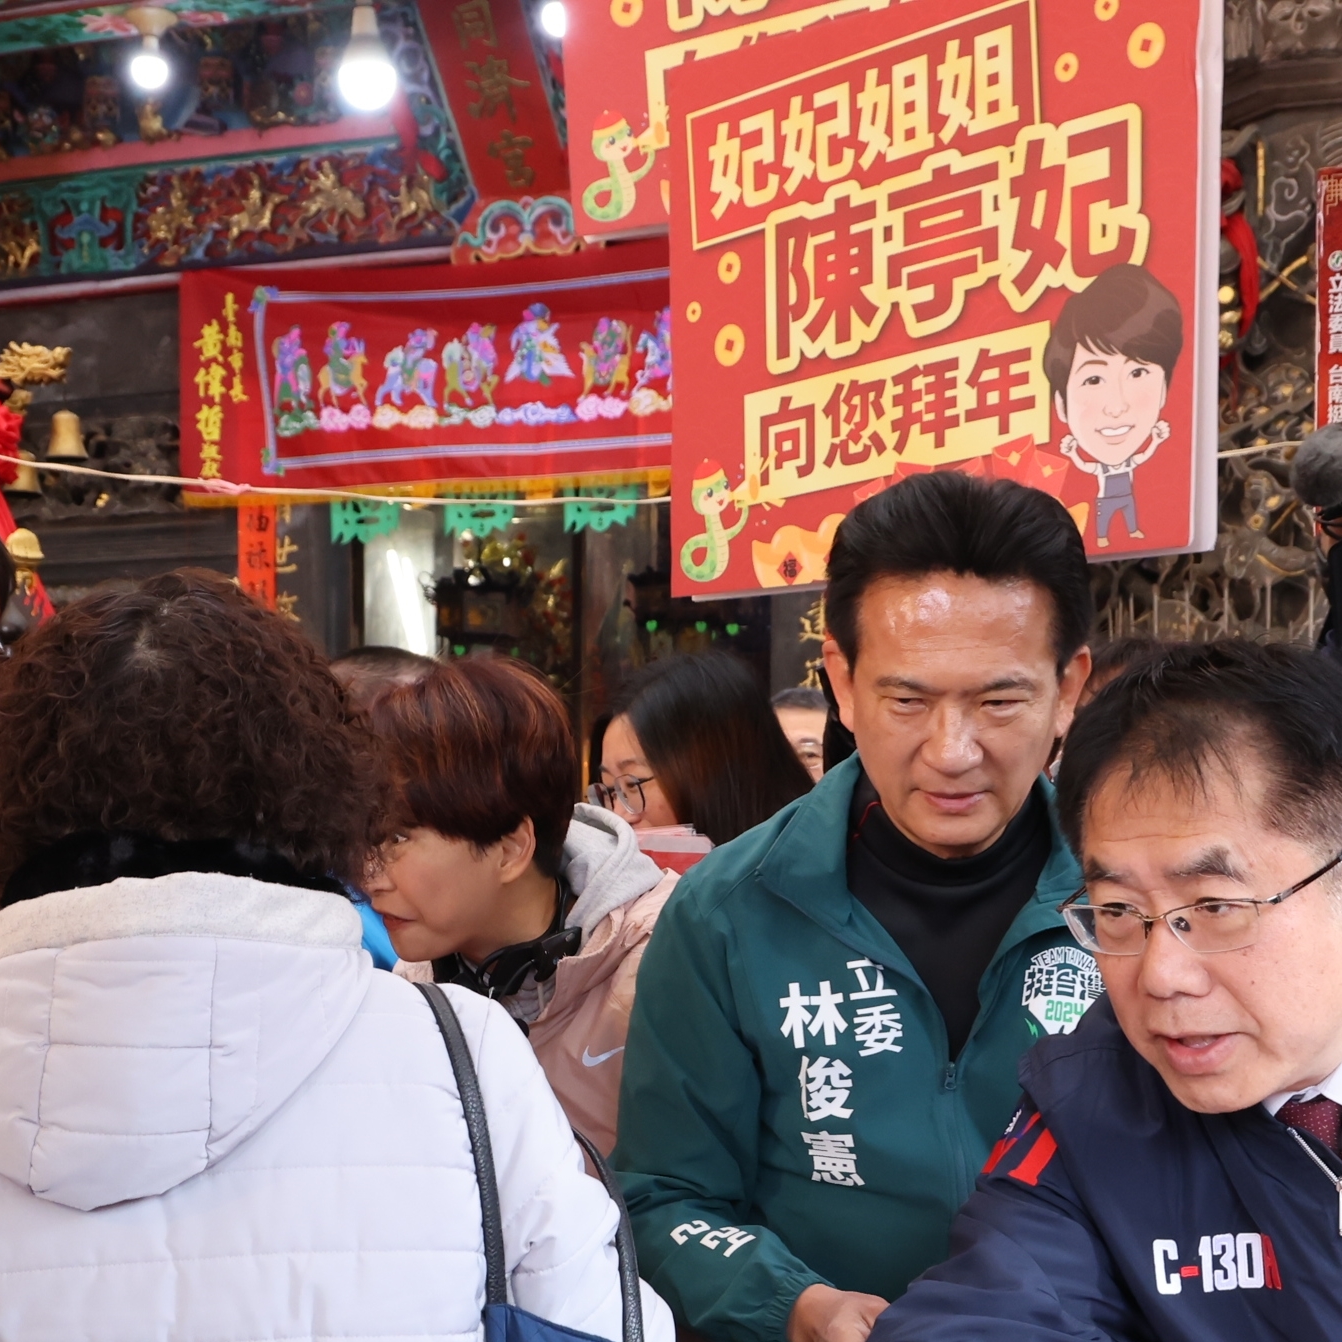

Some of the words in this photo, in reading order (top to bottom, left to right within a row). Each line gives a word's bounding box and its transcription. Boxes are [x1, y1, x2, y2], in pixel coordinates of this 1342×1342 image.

[708, 25, 1020, 220] 妃妃姐姐
[766, 105, 1150, 373] 陳亭妃
[758, 346, 1036, 485] 向您拜年
[846, 957, 904, 1057] 立委
[1031, 946, 1065, 966] TEAM
[779, 980, 866, 1187] 林俊憲
